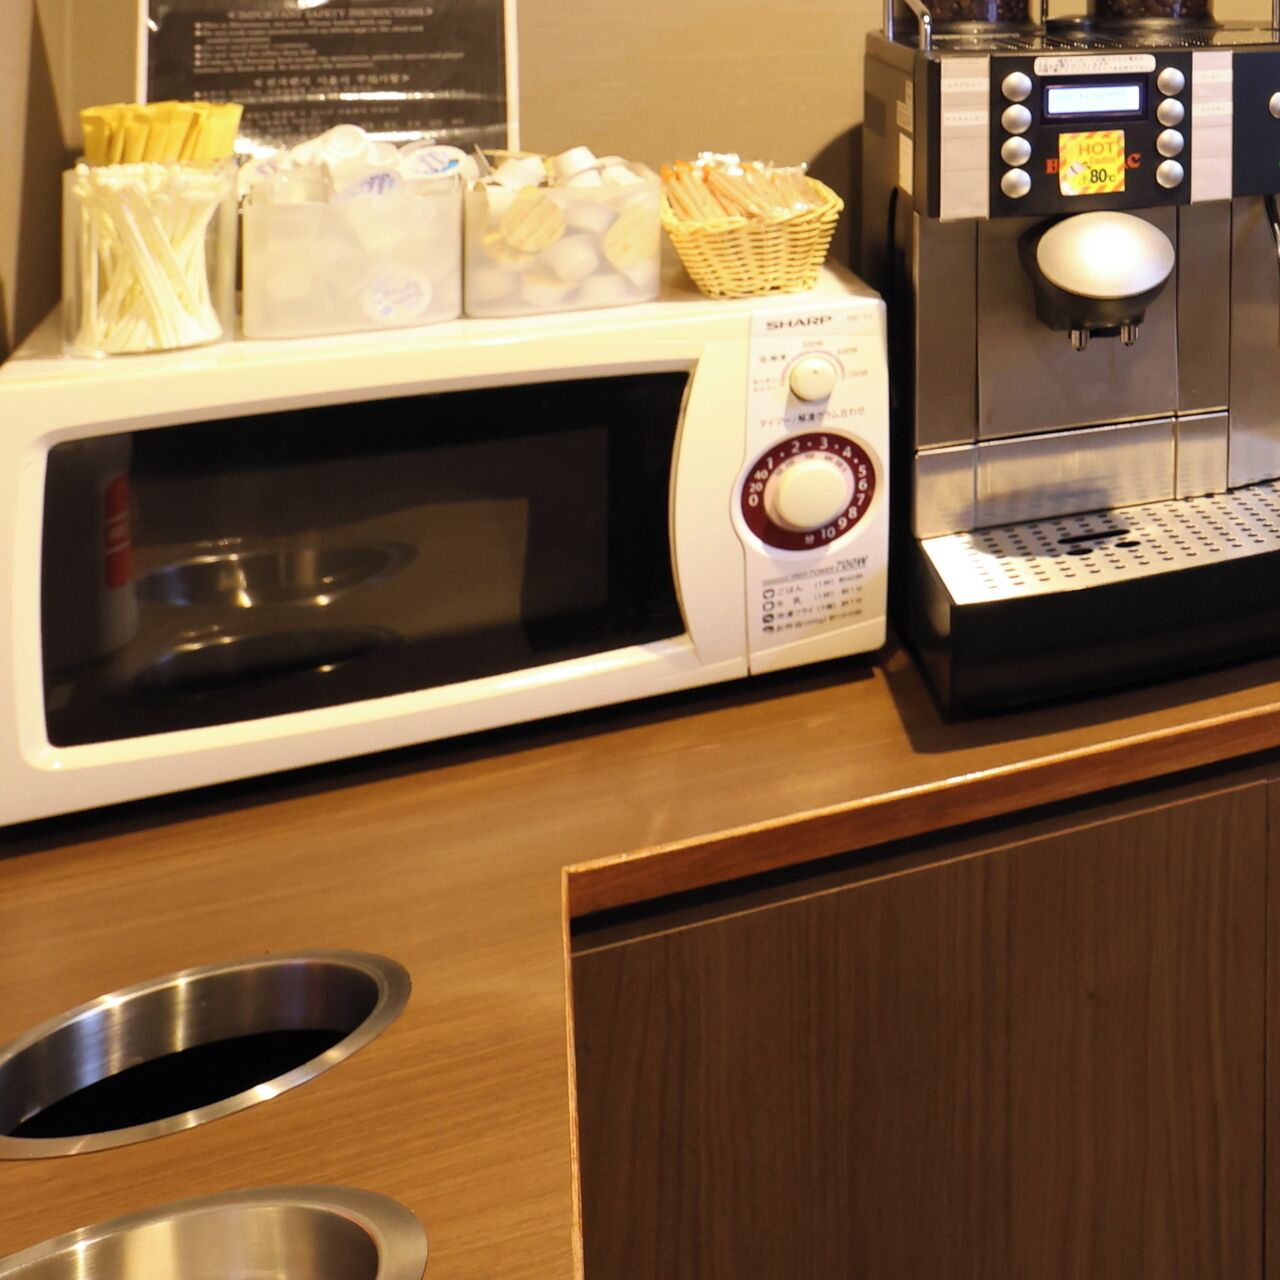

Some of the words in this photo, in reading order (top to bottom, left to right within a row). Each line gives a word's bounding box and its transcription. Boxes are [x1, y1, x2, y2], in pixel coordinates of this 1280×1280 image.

[1078, 142, 1114, 156] HOT
[765, 315, 833, 330] SHARP
[791, 441, 801, 454] 2
[819, 437, 829, 450] 3
[842, 446, 852, 459] 4
[766, 457, 774, 469] 1
[754, 469, 769, 481] 40
[858, 465, 867, 477] 5
[750, 482, 763, 492] 20
[858, 478, 868, 490] 6
[749, 494, 758, 507] 0
[857, 494, 865, 506] 7
[848, 507, 859, 520] 8
[838, 518, 848, 530] 9
[821, 527, 836, 540] 10
